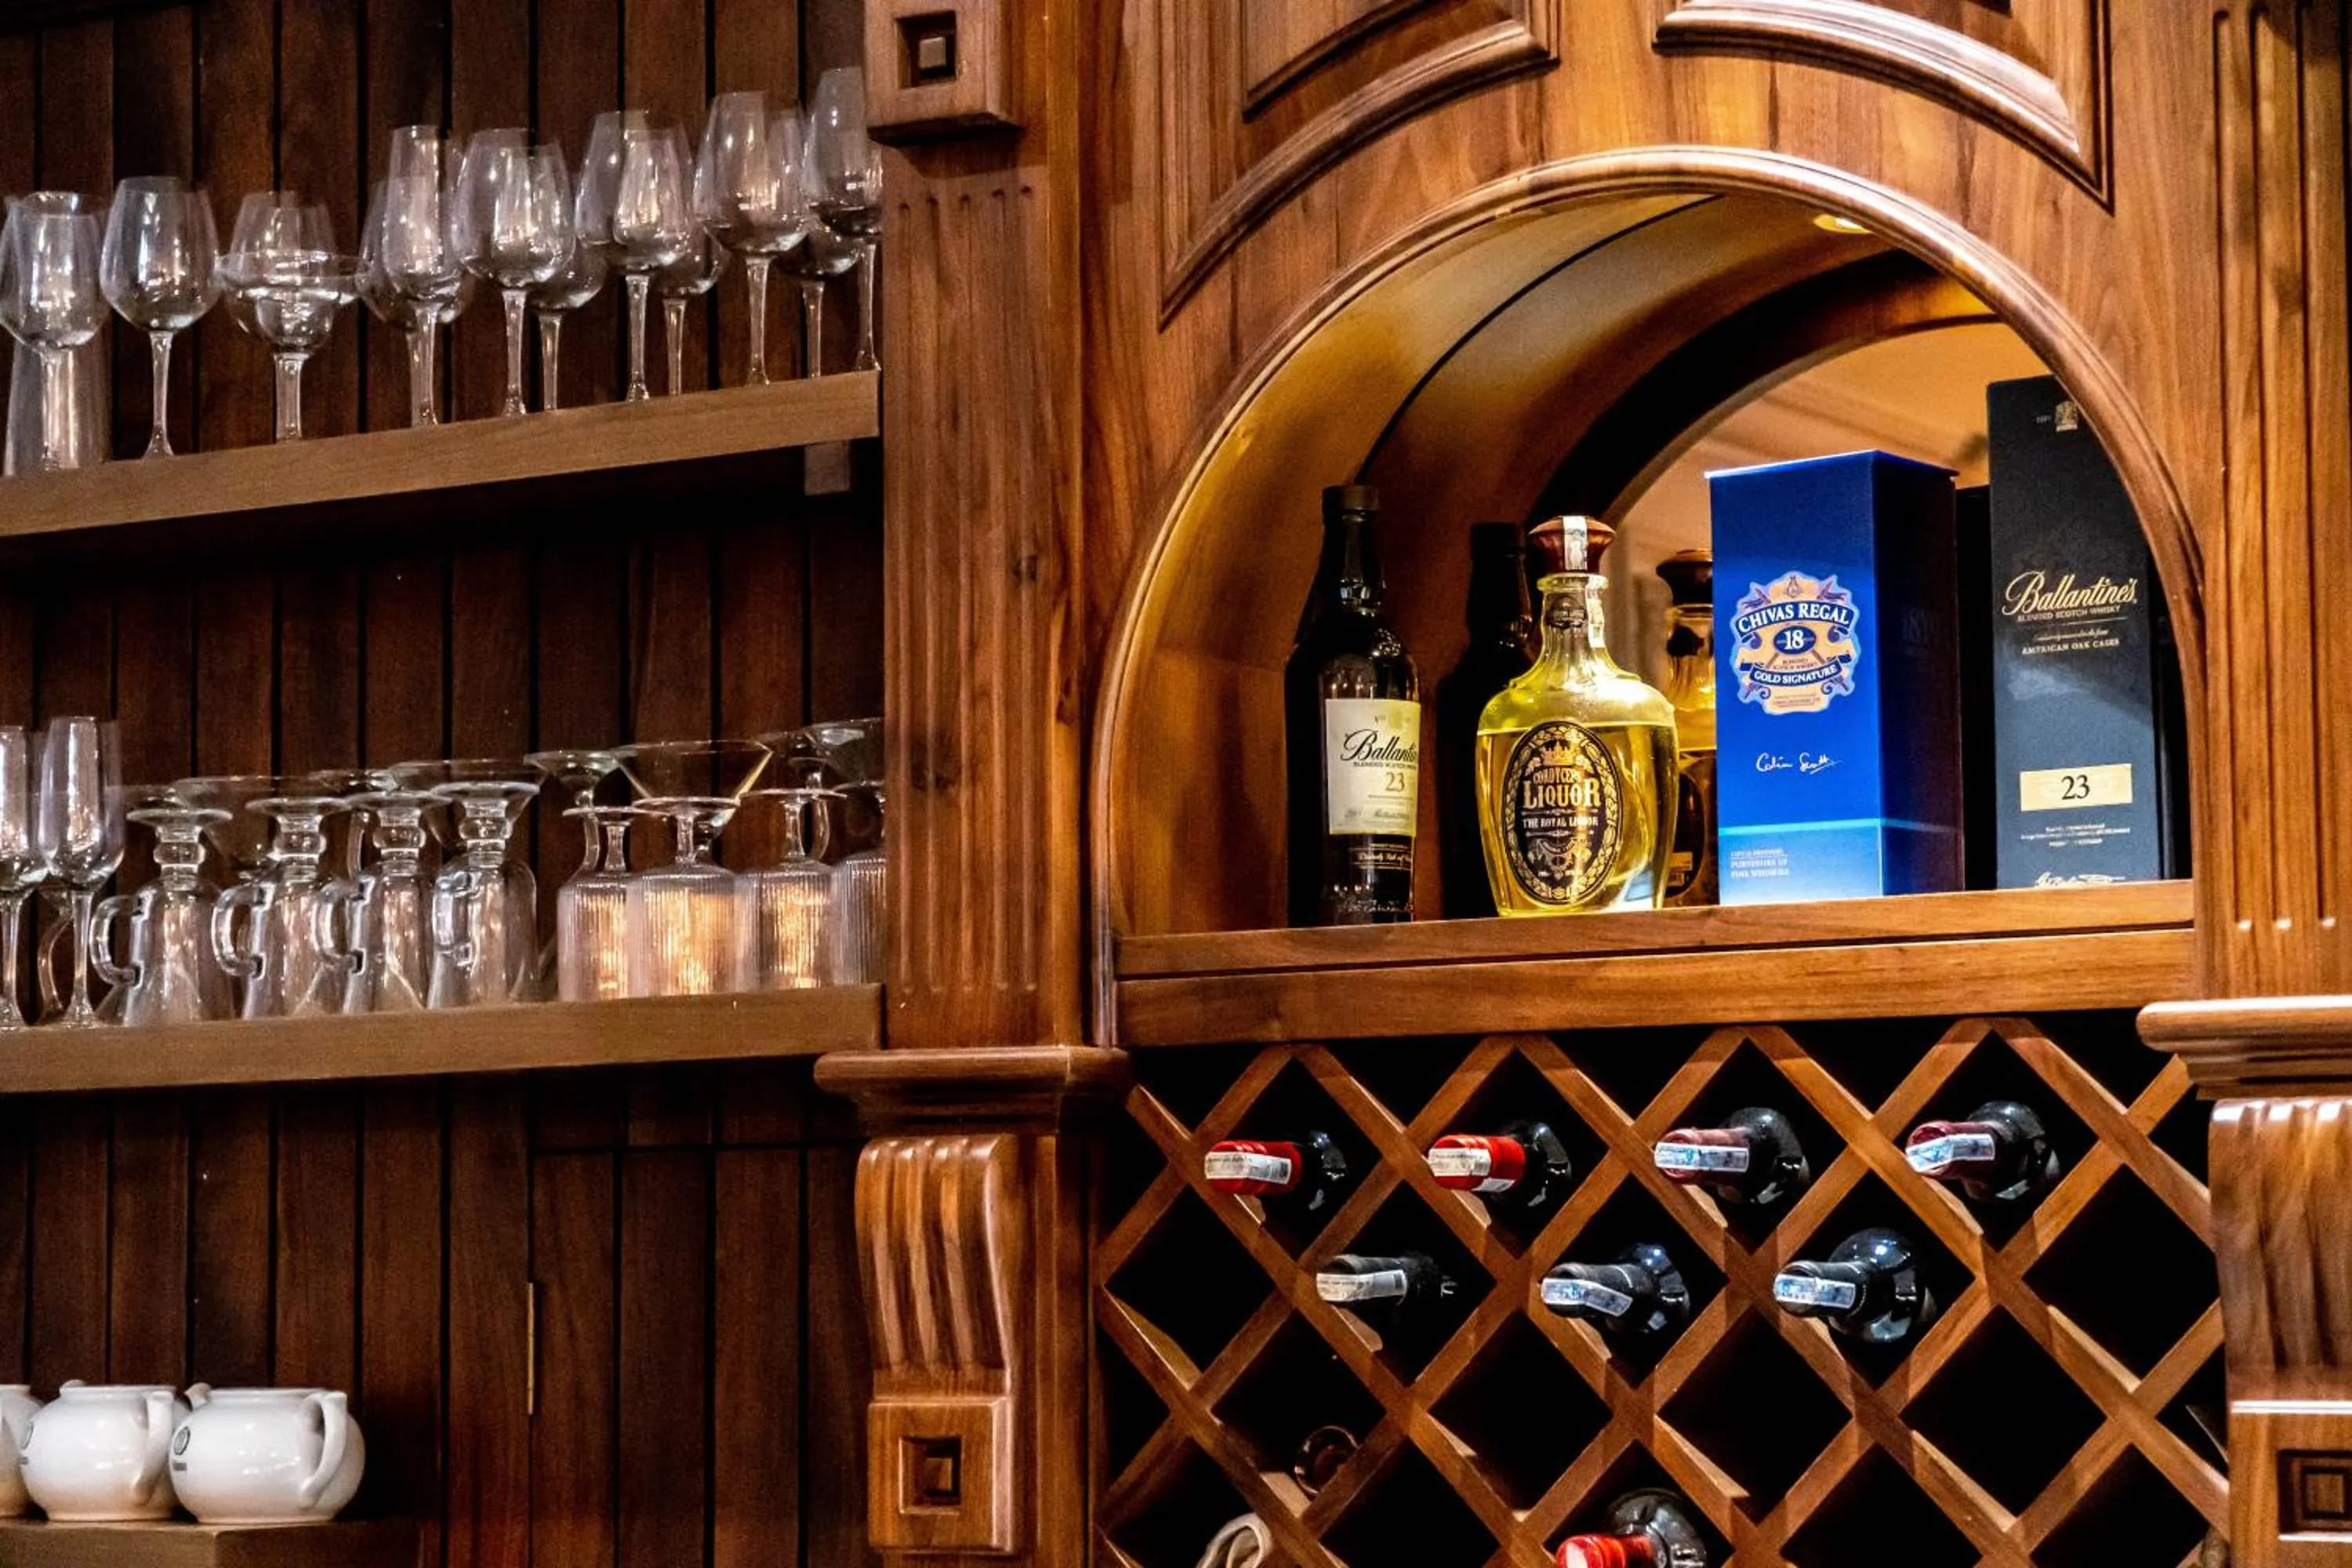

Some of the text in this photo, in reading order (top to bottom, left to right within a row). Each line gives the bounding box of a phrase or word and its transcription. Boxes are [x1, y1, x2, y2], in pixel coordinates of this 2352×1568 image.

[2002, 570, 2139, 615] Ballantine's
[1738, 603, 1849, 633] CHIVAS REGAL
[2056, 609, 2088, 619] SCOTCH
[1784, 630, 1804, 650] 18
[2071, 641, 2090, 650] OAK
[1754, 670, 1781, 684] GOLD
[1782, 665, 1838, 684] SIGNATURE
[1385, 771, 1406, 792] 23
[2061, 774, 2090, 800] 23
[1523, 778, 1602, 808] LIQUOR
[1523, 818, 1539, 829] THE
[1541, 817, 1567, 828] ROYAL
